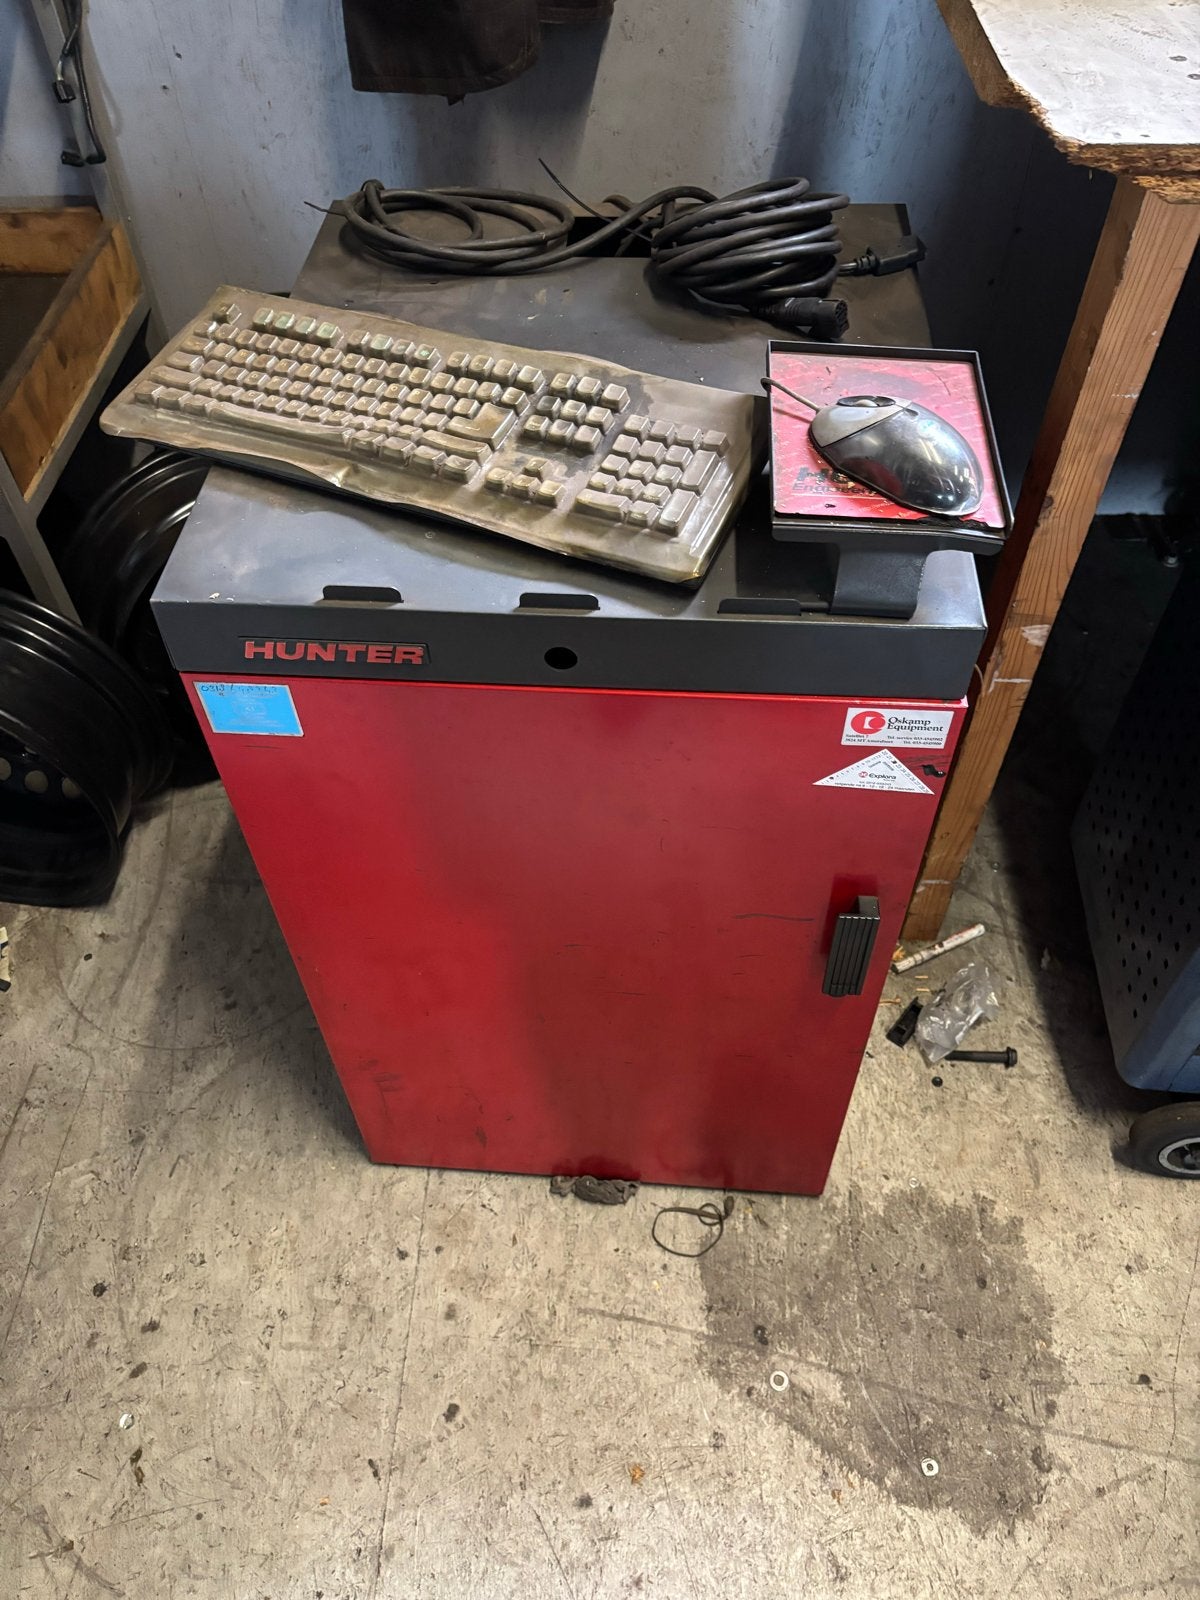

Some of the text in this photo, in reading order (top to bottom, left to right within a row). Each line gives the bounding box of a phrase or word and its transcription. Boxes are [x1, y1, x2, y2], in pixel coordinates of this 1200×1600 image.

[244, 640, 425, 665] HUNTER
[888, 716, 931, 726] Oskamp
[887, 723, 943, 732] Equipment
